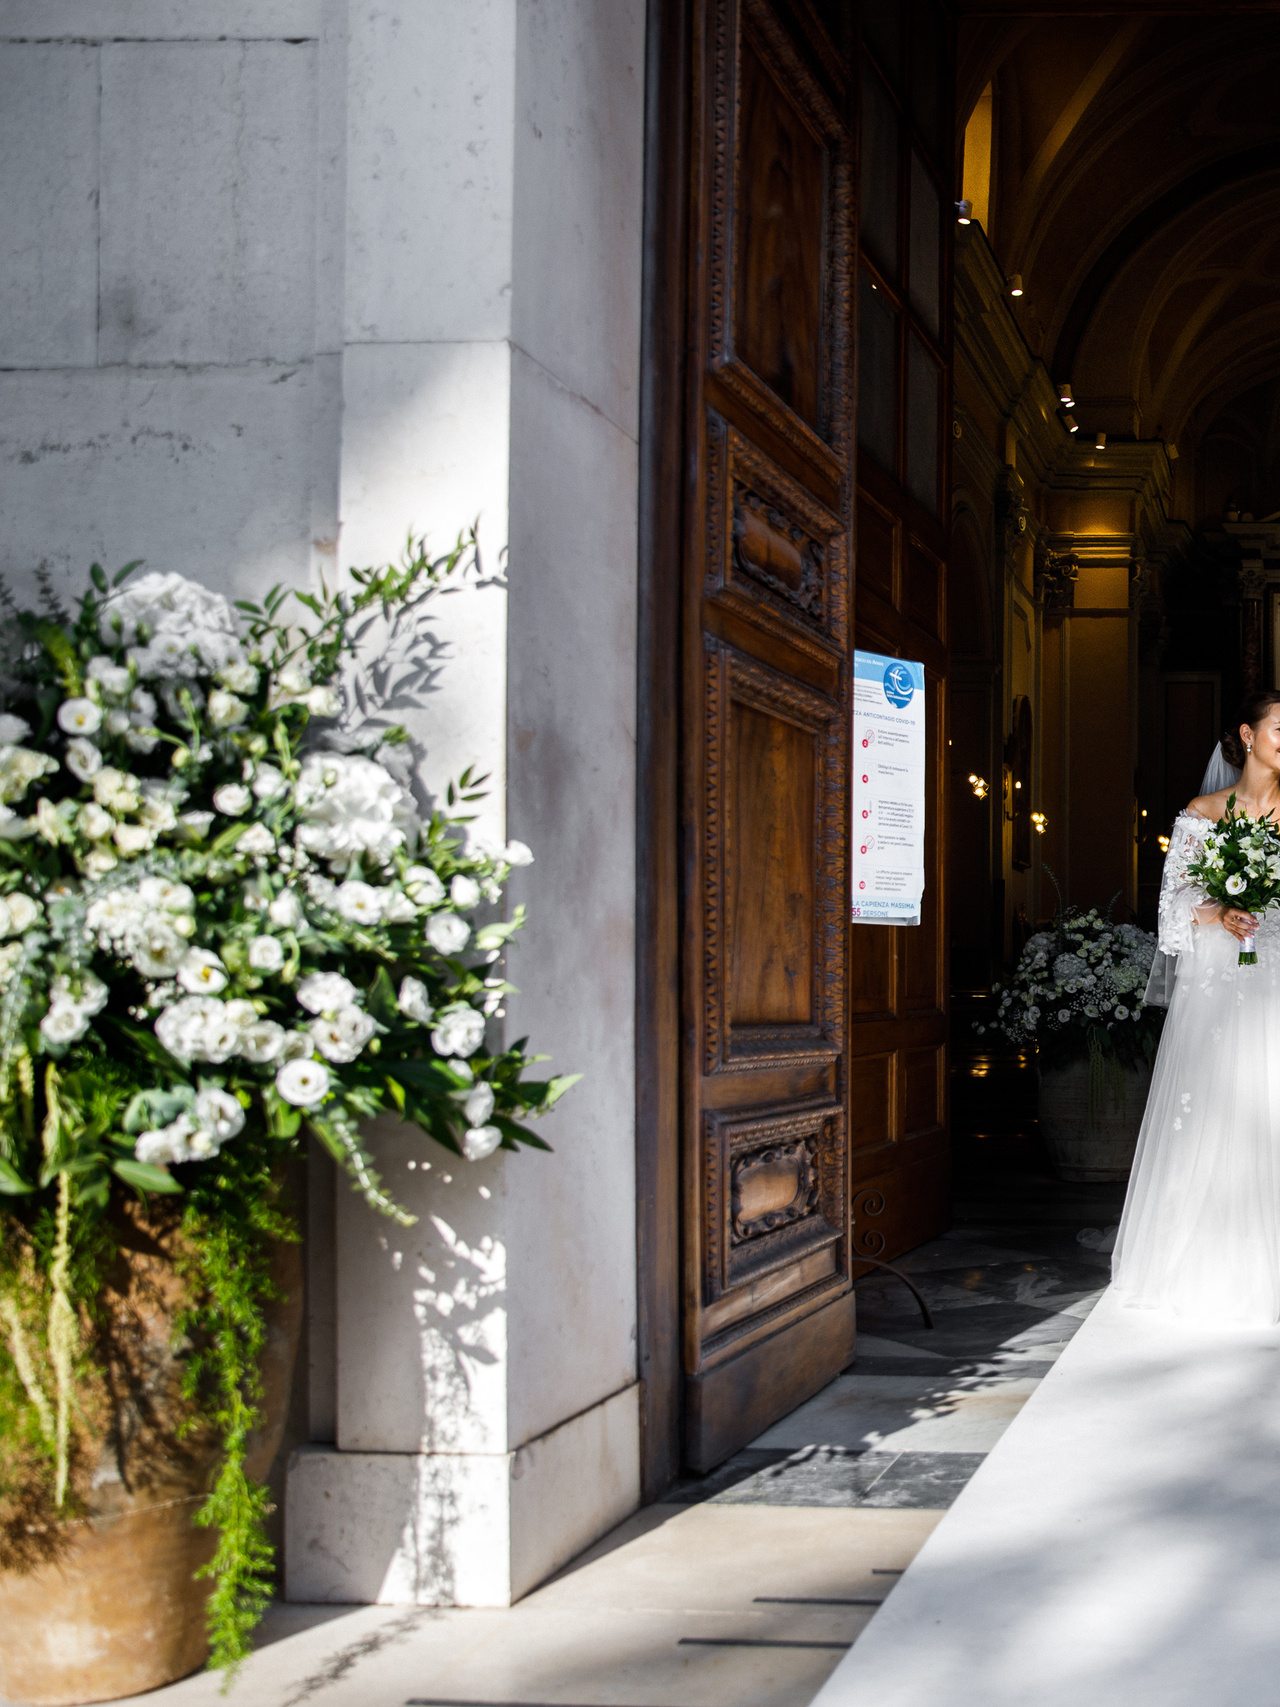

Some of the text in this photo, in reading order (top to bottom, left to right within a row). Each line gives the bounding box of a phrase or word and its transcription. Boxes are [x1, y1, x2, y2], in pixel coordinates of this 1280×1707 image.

[863, 711, 895, 722] ANTICONTAGIO
[896, 717, 915, 725] COVID-19
[861, 900, 889, 908] CAPIENZA
[890, 902, 915, 910] MASSIMA
